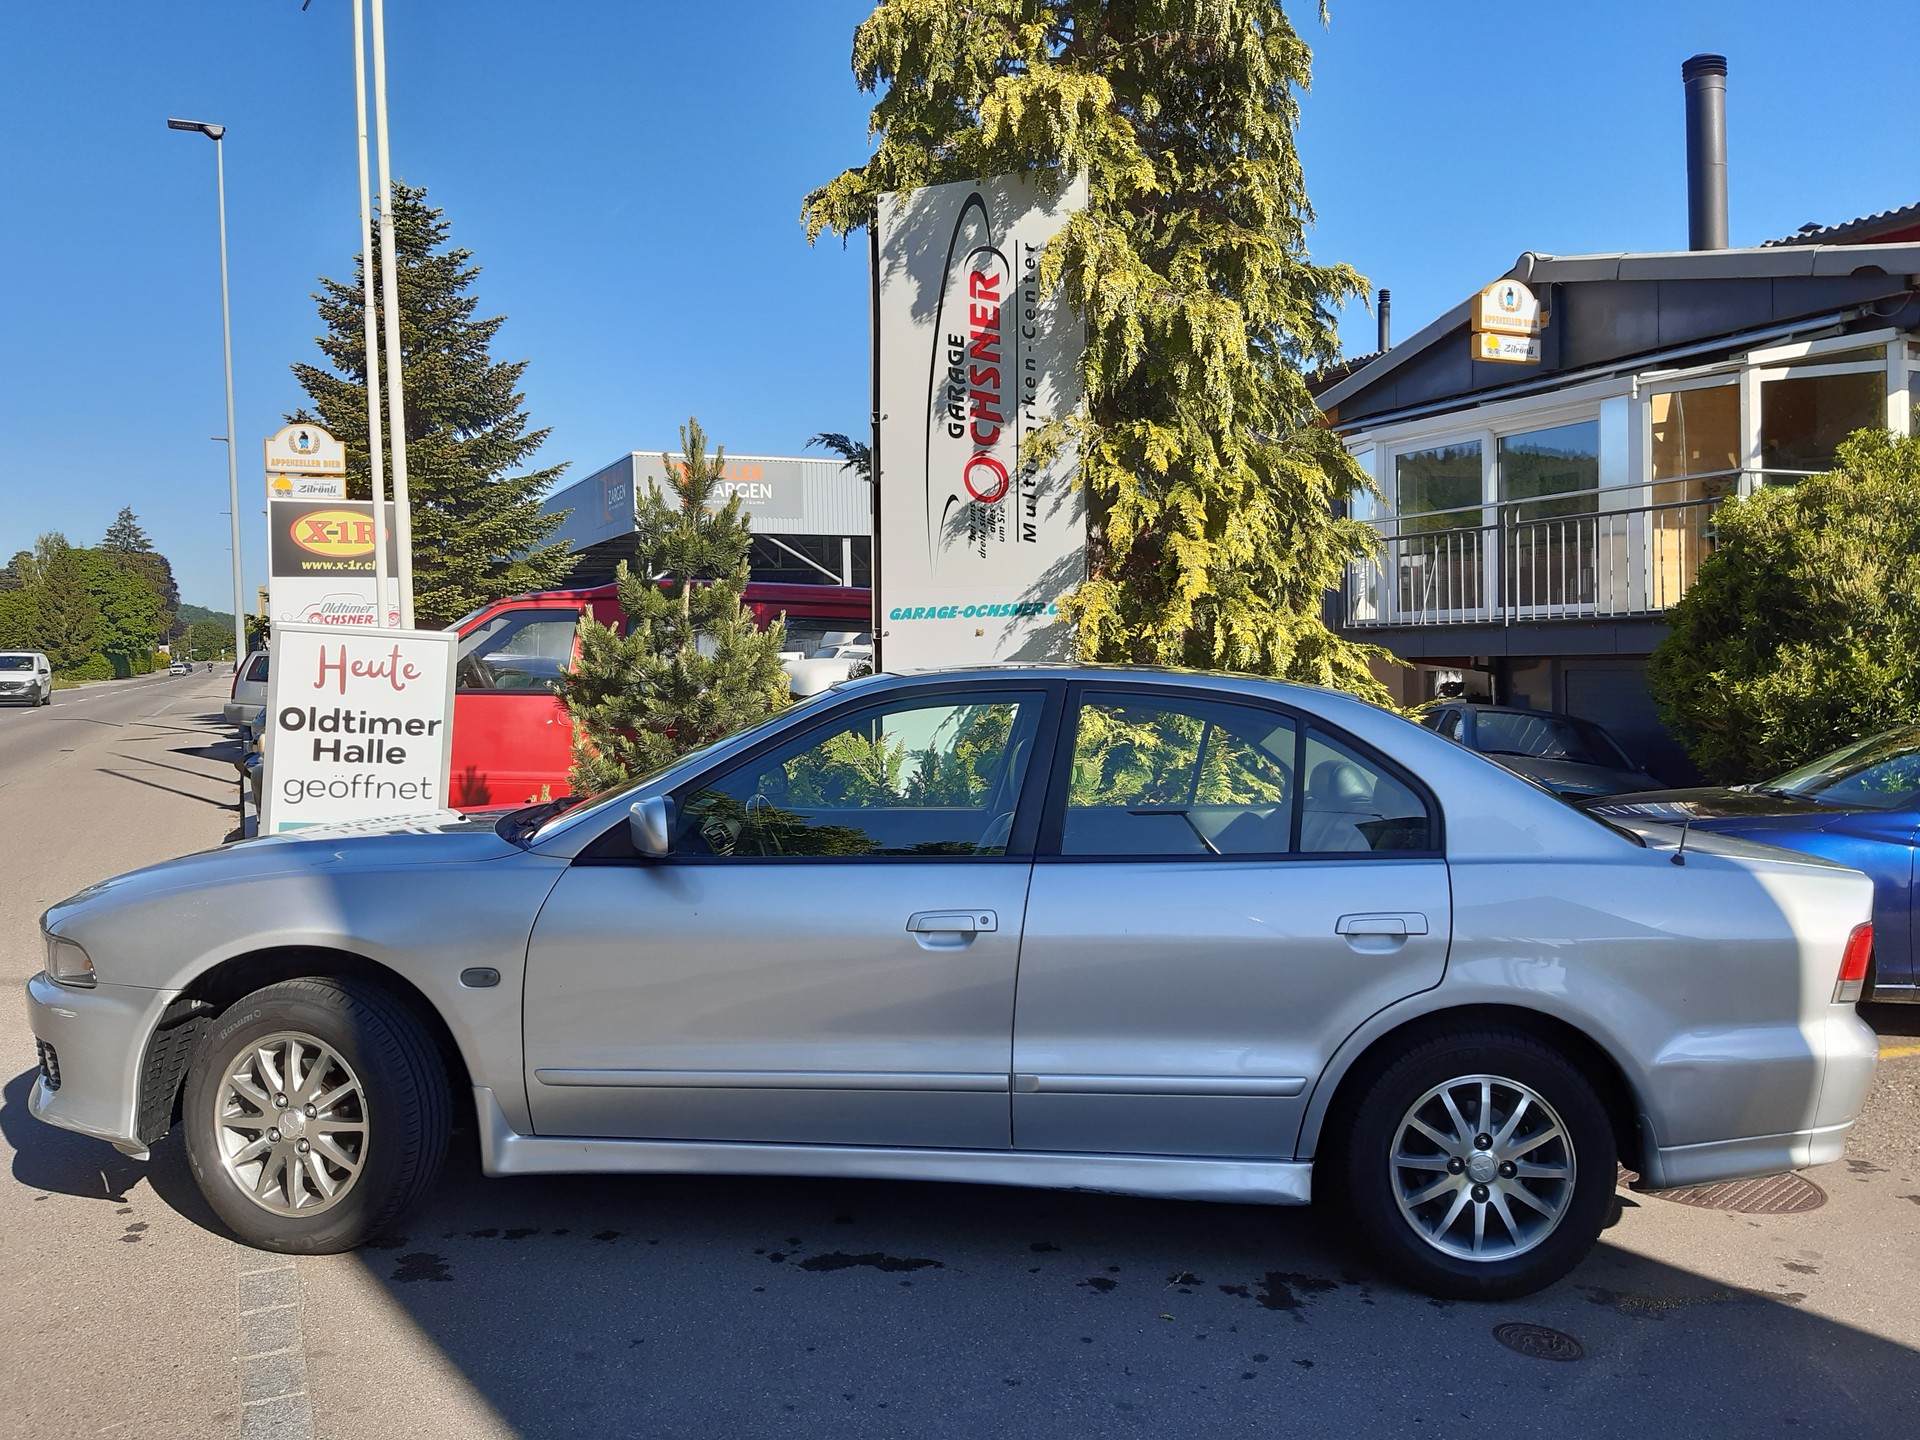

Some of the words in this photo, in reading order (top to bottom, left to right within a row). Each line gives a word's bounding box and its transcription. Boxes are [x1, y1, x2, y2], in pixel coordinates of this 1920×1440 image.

[948, 333, 967, 439] GARAGE
[963, 270, 1010, 504] OCHSNER
[271, 458, 320, 467] APPENZELLER
[323, 460, 341, 468] BIER
[708, 482, 772, 498] ARGEN
[977, 507, 986, 528] sich
[987, 507, 996, 533] alles
[997, 506, 1005, 524] Sie
[303, 521, 376, 543] X-1R
[968, 524, 976, 542] bei
[978, 529, 986, 559] dreht
[999, 526, 1005, 543] um
[320, 602, 374, 614] Oldtimer
[313, 644, 422, 696] Heute
[279, 706, 442, 736] Oldtimer
[313, 738, 407, 764] Halle
[283, 773, 433, 805] geöffnet
[220, 1013, 253, 1040] Barum
